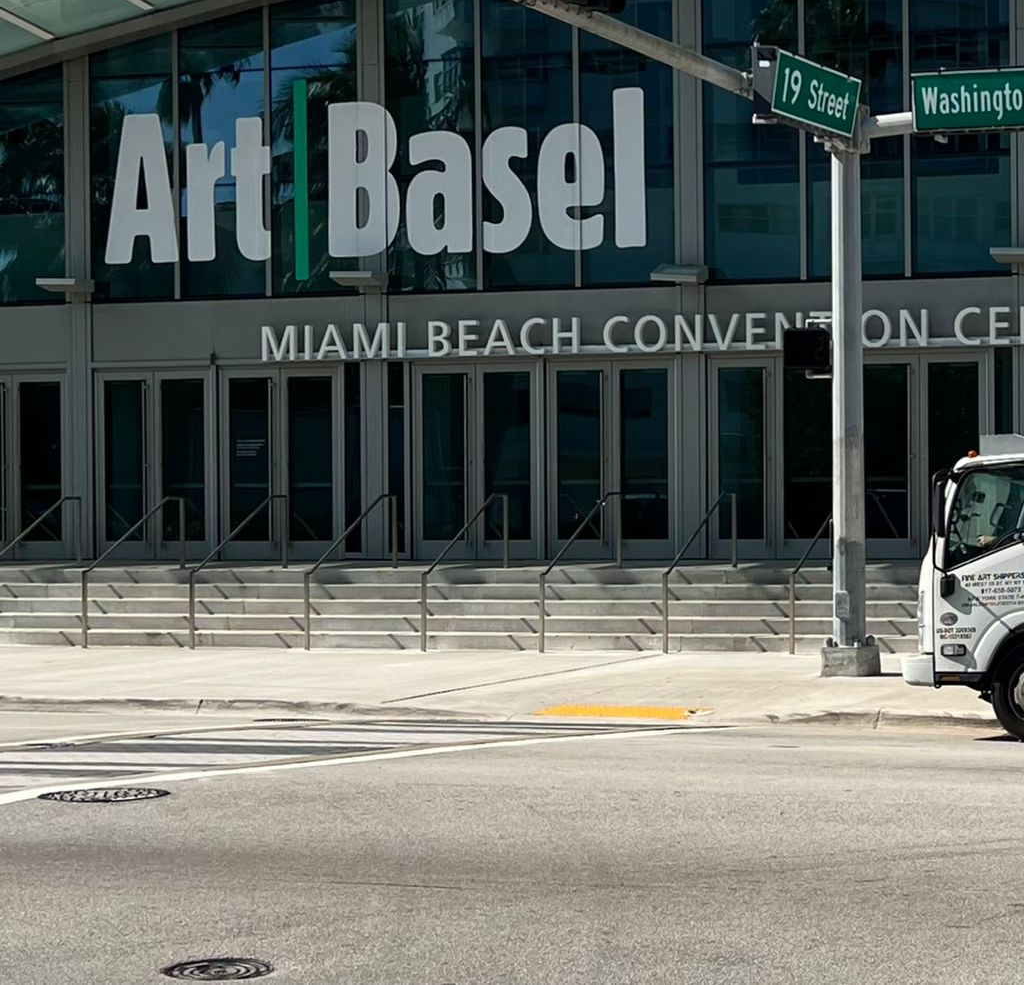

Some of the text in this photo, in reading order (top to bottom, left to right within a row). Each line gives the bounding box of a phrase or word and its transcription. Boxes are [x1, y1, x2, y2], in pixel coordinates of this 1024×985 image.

[781, 67, 850, 120] 19 Street
[104, 86, 647, 266] Art Basel
[261, 322, 407, 361] MIAMI
[428, 316, 580, 357] BEACH
[603, 308, 929, 353] CONVENON
[977, 573, 992, 581] ART
